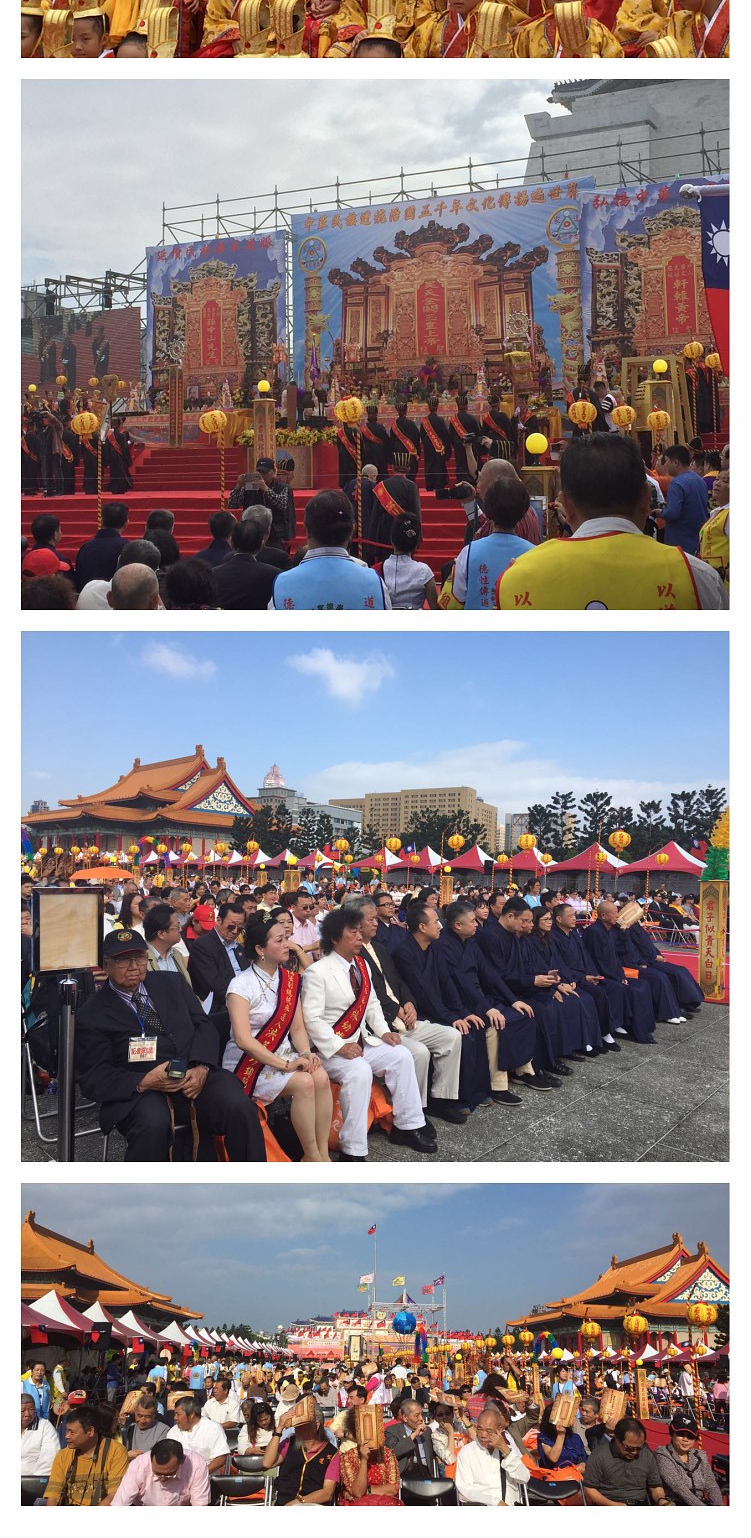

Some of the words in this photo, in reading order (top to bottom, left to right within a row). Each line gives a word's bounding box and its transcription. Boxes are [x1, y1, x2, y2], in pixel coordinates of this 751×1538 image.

[514, 591, 532, 607] 以
[705, 900, 715, 980] 君子似青天白日
